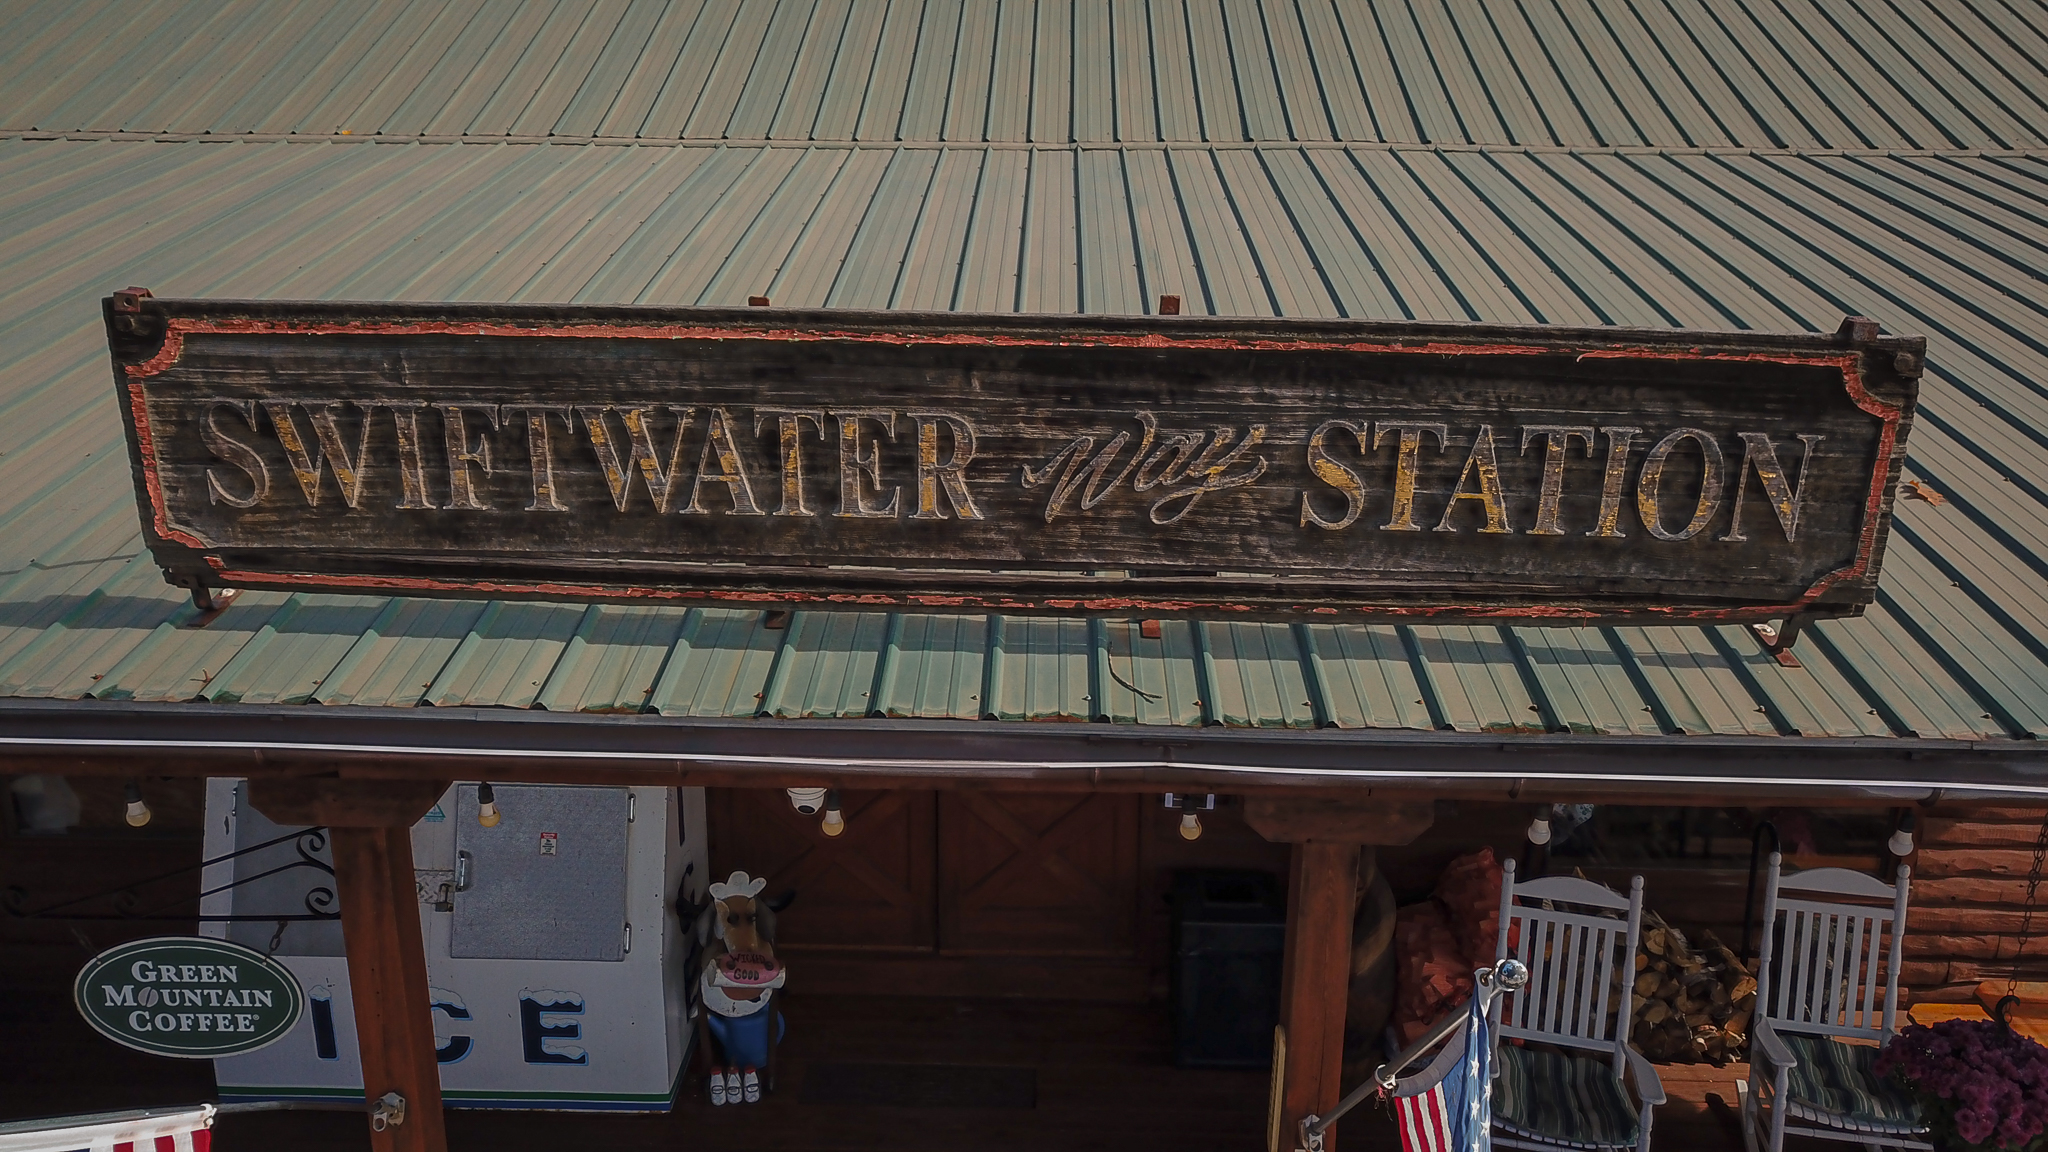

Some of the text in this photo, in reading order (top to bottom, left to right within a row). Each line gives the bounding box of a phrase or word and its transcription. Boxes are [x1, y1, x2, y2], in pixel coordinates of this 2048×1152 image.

[200, 398, 1826, 543] SWIFTWATER Way STATION
[131, 960, 238, 983] GREEN
[733, 968, 759, 981] GOOD
[101, 984, 273, 1008] MOUNTAIN
